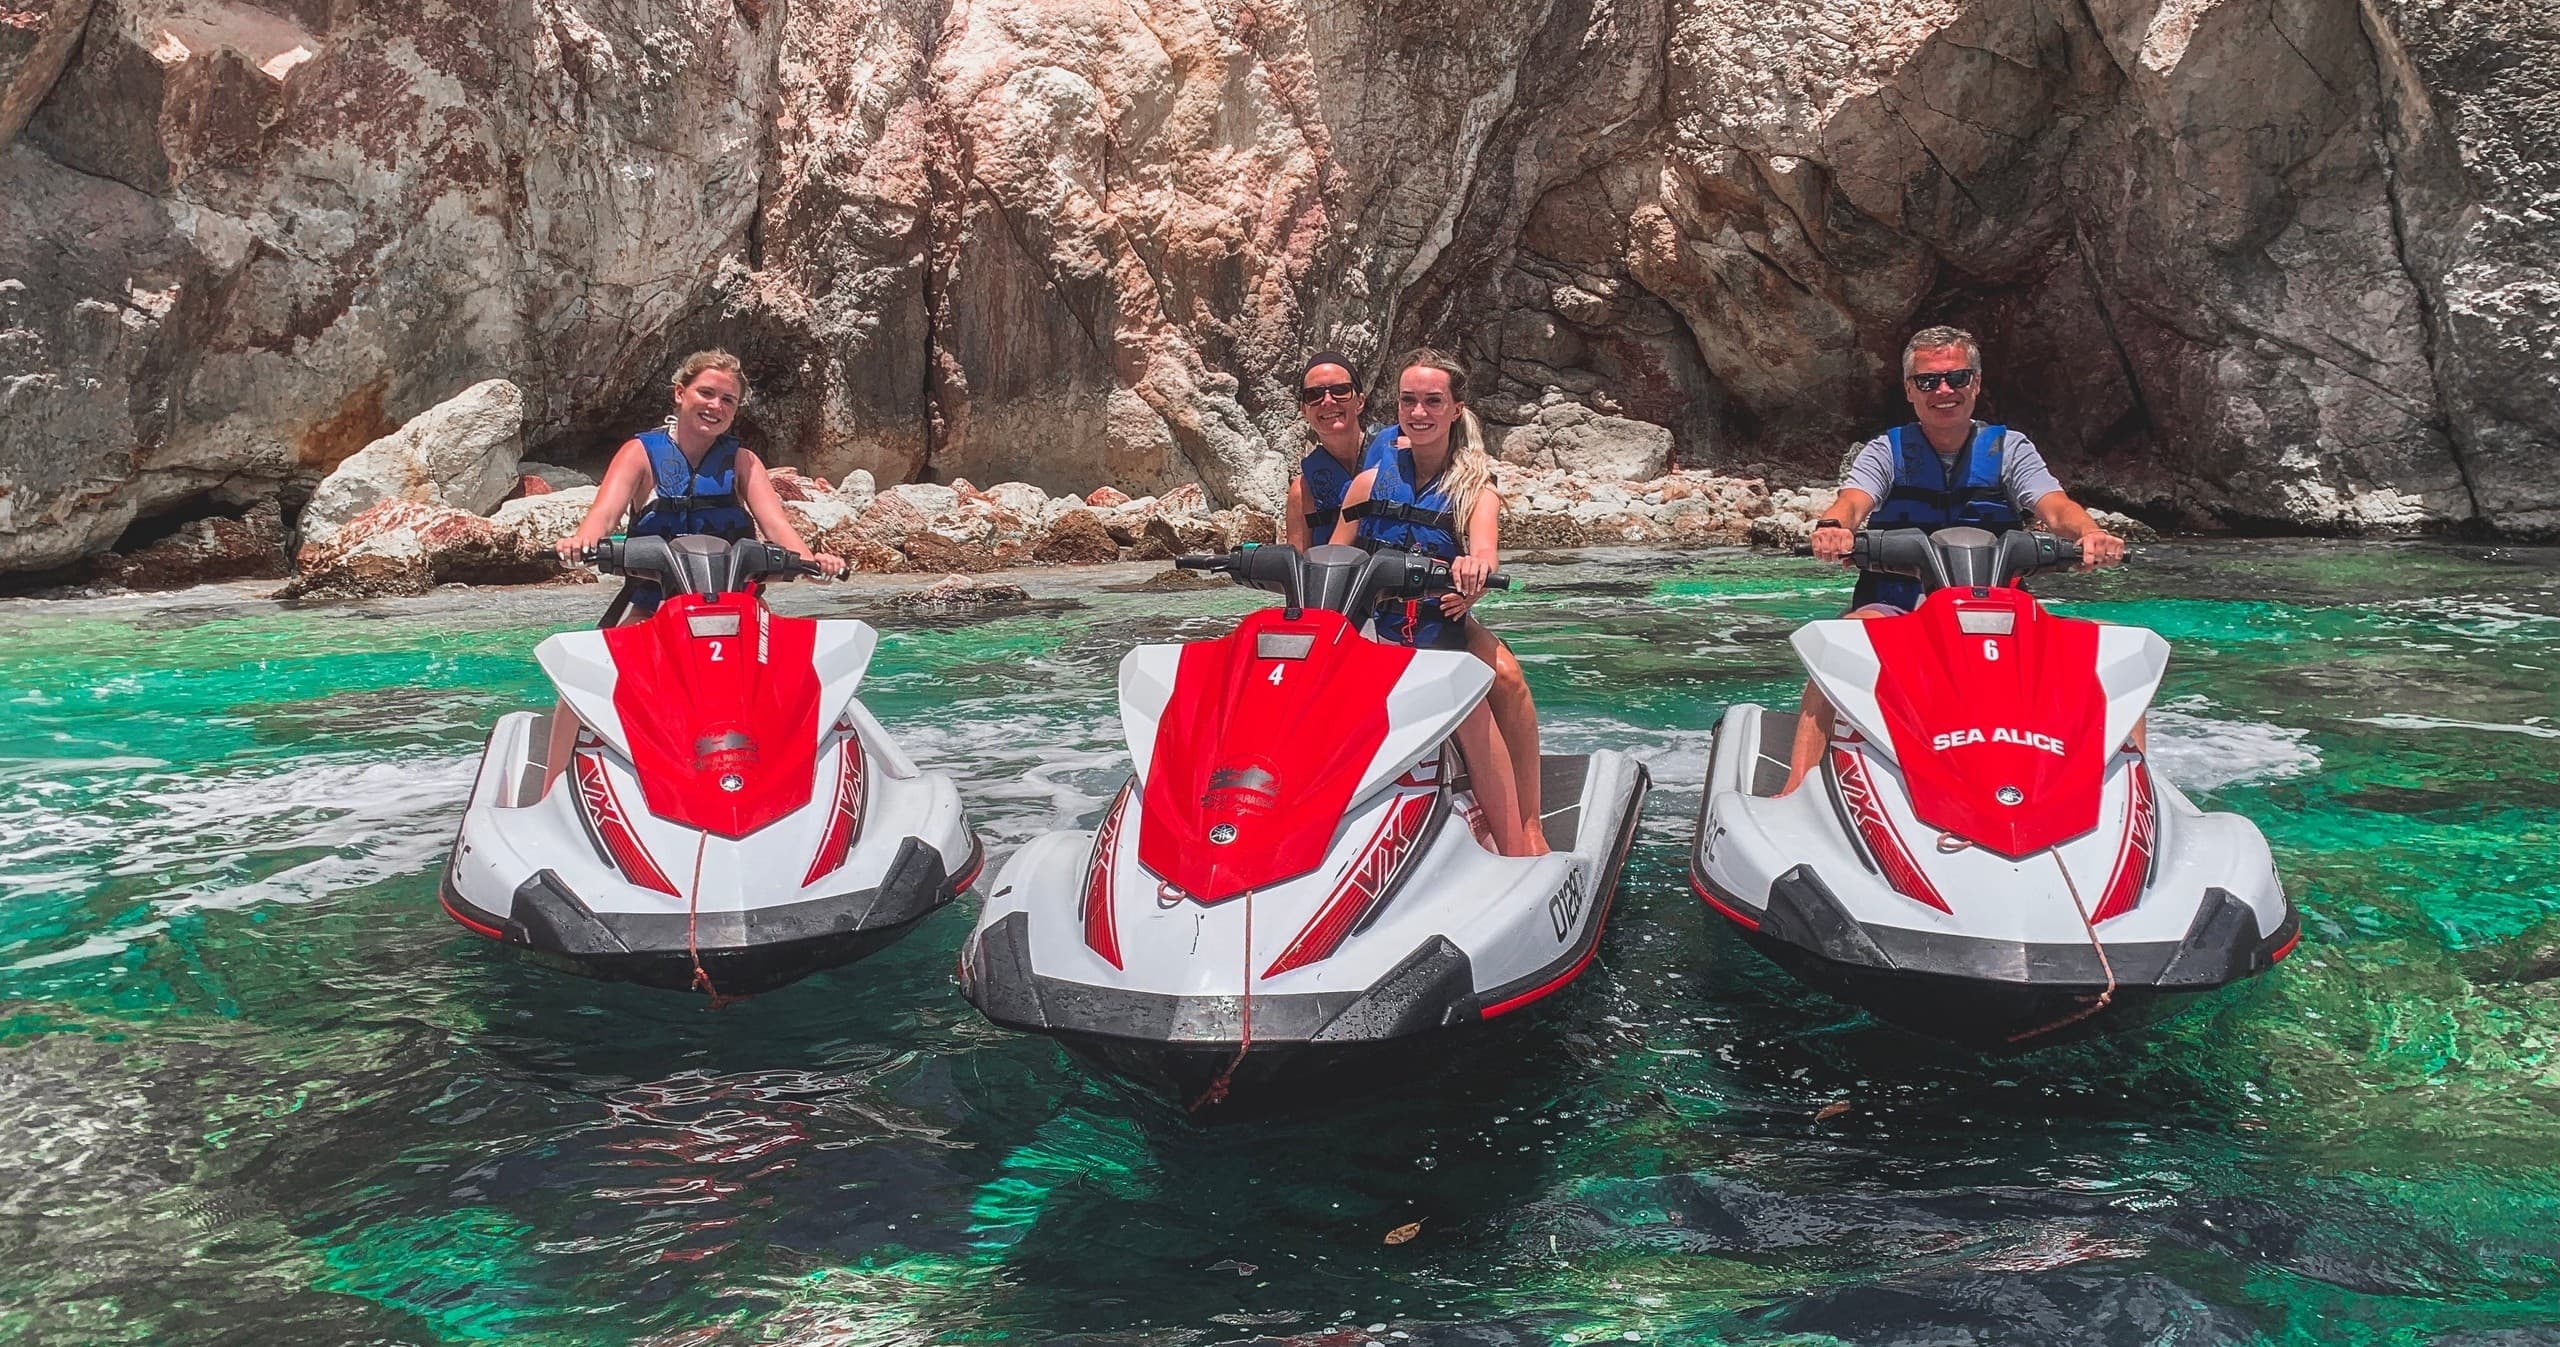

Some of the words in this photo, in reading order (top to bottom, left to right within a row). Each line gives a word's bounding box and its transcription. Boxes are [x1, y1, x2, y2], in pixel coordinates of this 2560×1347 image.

[708, 641, 724, 662] 2
[1267, 662, 1285, 686] 4
[1983, 639, 2000, 661] 6
[1932, 728, 1986, 751] SEA
[1991, 727, 2065, 756] ALICE
[581, 767, 622, 827] VX
[839, 750, 861, 820] VX
[1839, 762, 1886, 826] VX
[1092, 802, 1122, 870] VX
[2130, 778, 2154, 858] VX
[1352, 810, 1411, 900] VX
